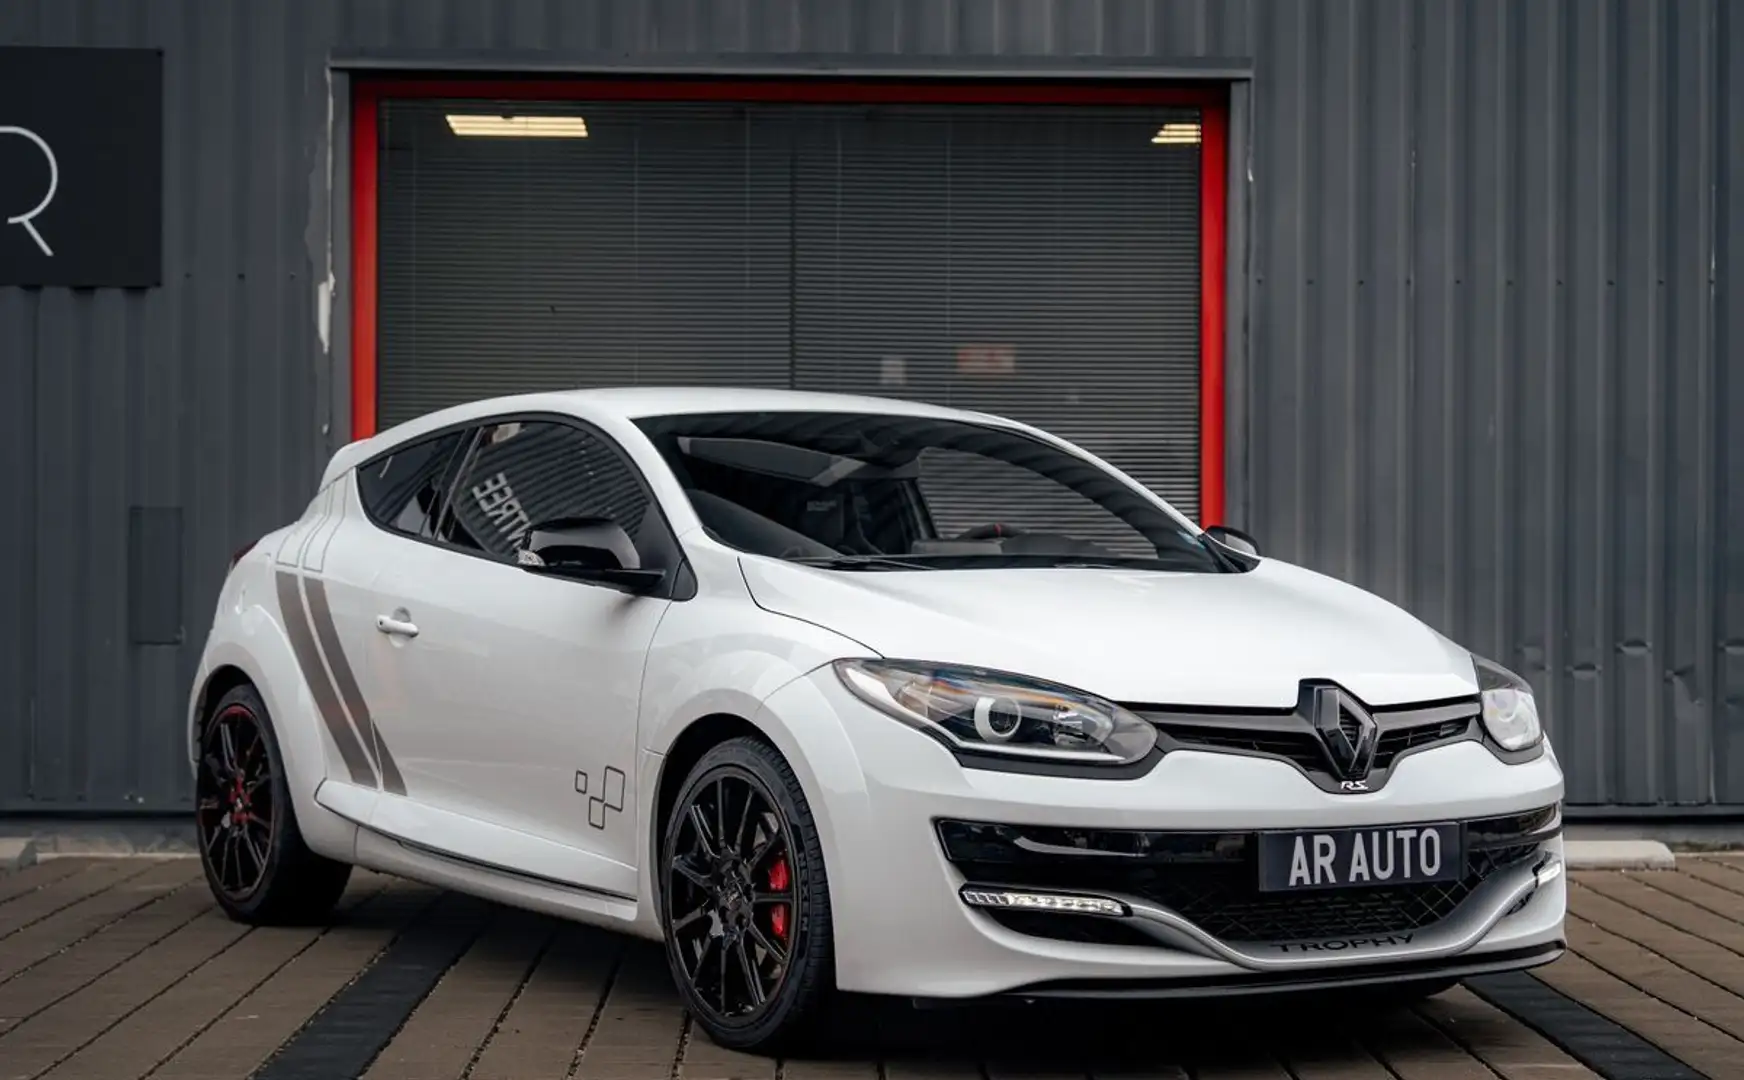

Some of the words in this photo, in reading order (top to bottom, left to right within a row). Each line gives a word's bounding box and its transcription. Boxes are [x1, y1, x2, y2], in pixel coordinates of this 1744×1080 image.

[1288, 834, 1337, 887] AR
[1349, 828, 1441, 882] AUTO
[1271, 933, 1414, 953] TROPHY
